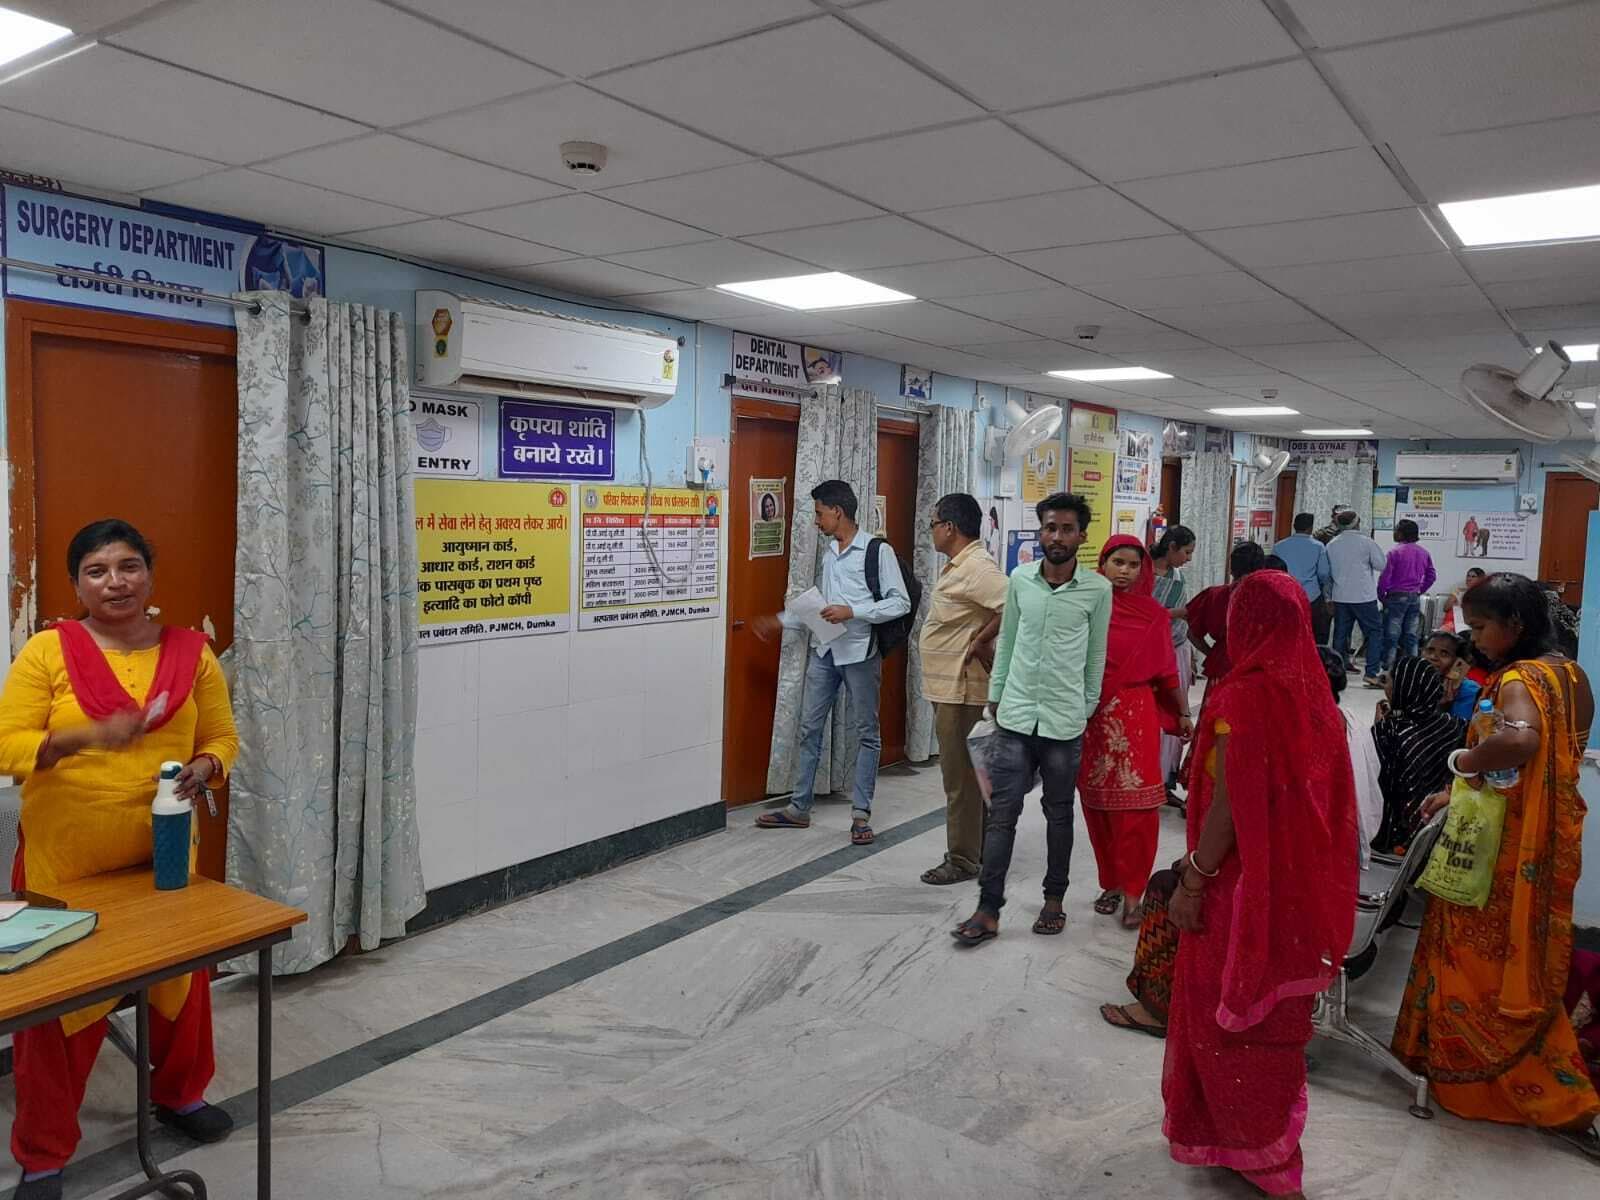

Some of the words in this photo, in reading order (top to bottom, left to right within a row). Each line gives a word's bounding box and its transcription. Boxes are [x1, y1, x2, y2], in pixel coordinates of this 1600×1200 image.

[17, 200, 114, 248] SURGERY
[119, 221, 235, 271] DEPARTMENT
[750, 337, 788, 359] DENTAL
[735, 354, 800, 379] DEPARTMENT
[422, 402, 469, 417] MASK
[509, 416, 563, 441] कृपया
[568, 417, 607, 439] शांति
[417, 457, 472, 470] ENTRY
[513, 443, 561, 464] बनाये
[438, 513, 457, 530] सेवा
[460, 513, 476, 530] लेने
[479, 513, 492, 535] हेतु
[495, 517, 521, 531] अवश्य
[523, 513, 544, 531] लेकर
[442, 541, 490, 556] आयुष्मान
[421, 561, 454, 573] आधार
[486, 559, 513, 571] राशन
[516, 556, 536, 569] कार्ड
[435, 579, 475, 594] पासबुक
[478, 578, 492, 589] का
[495, 577, 520, 588] प्रथम
[523, 576, 543, 591] पृष्ठ
[423, 596, 459, 614] इत्यादि
[463, 597, 477, 609] का
[480, 594, 505, 608] फोटो
[507, 591, 532, 605] कॉपी
[433, 626, 457, 638] प्रबंधन
[527, 620, 555, 630] Dumka
